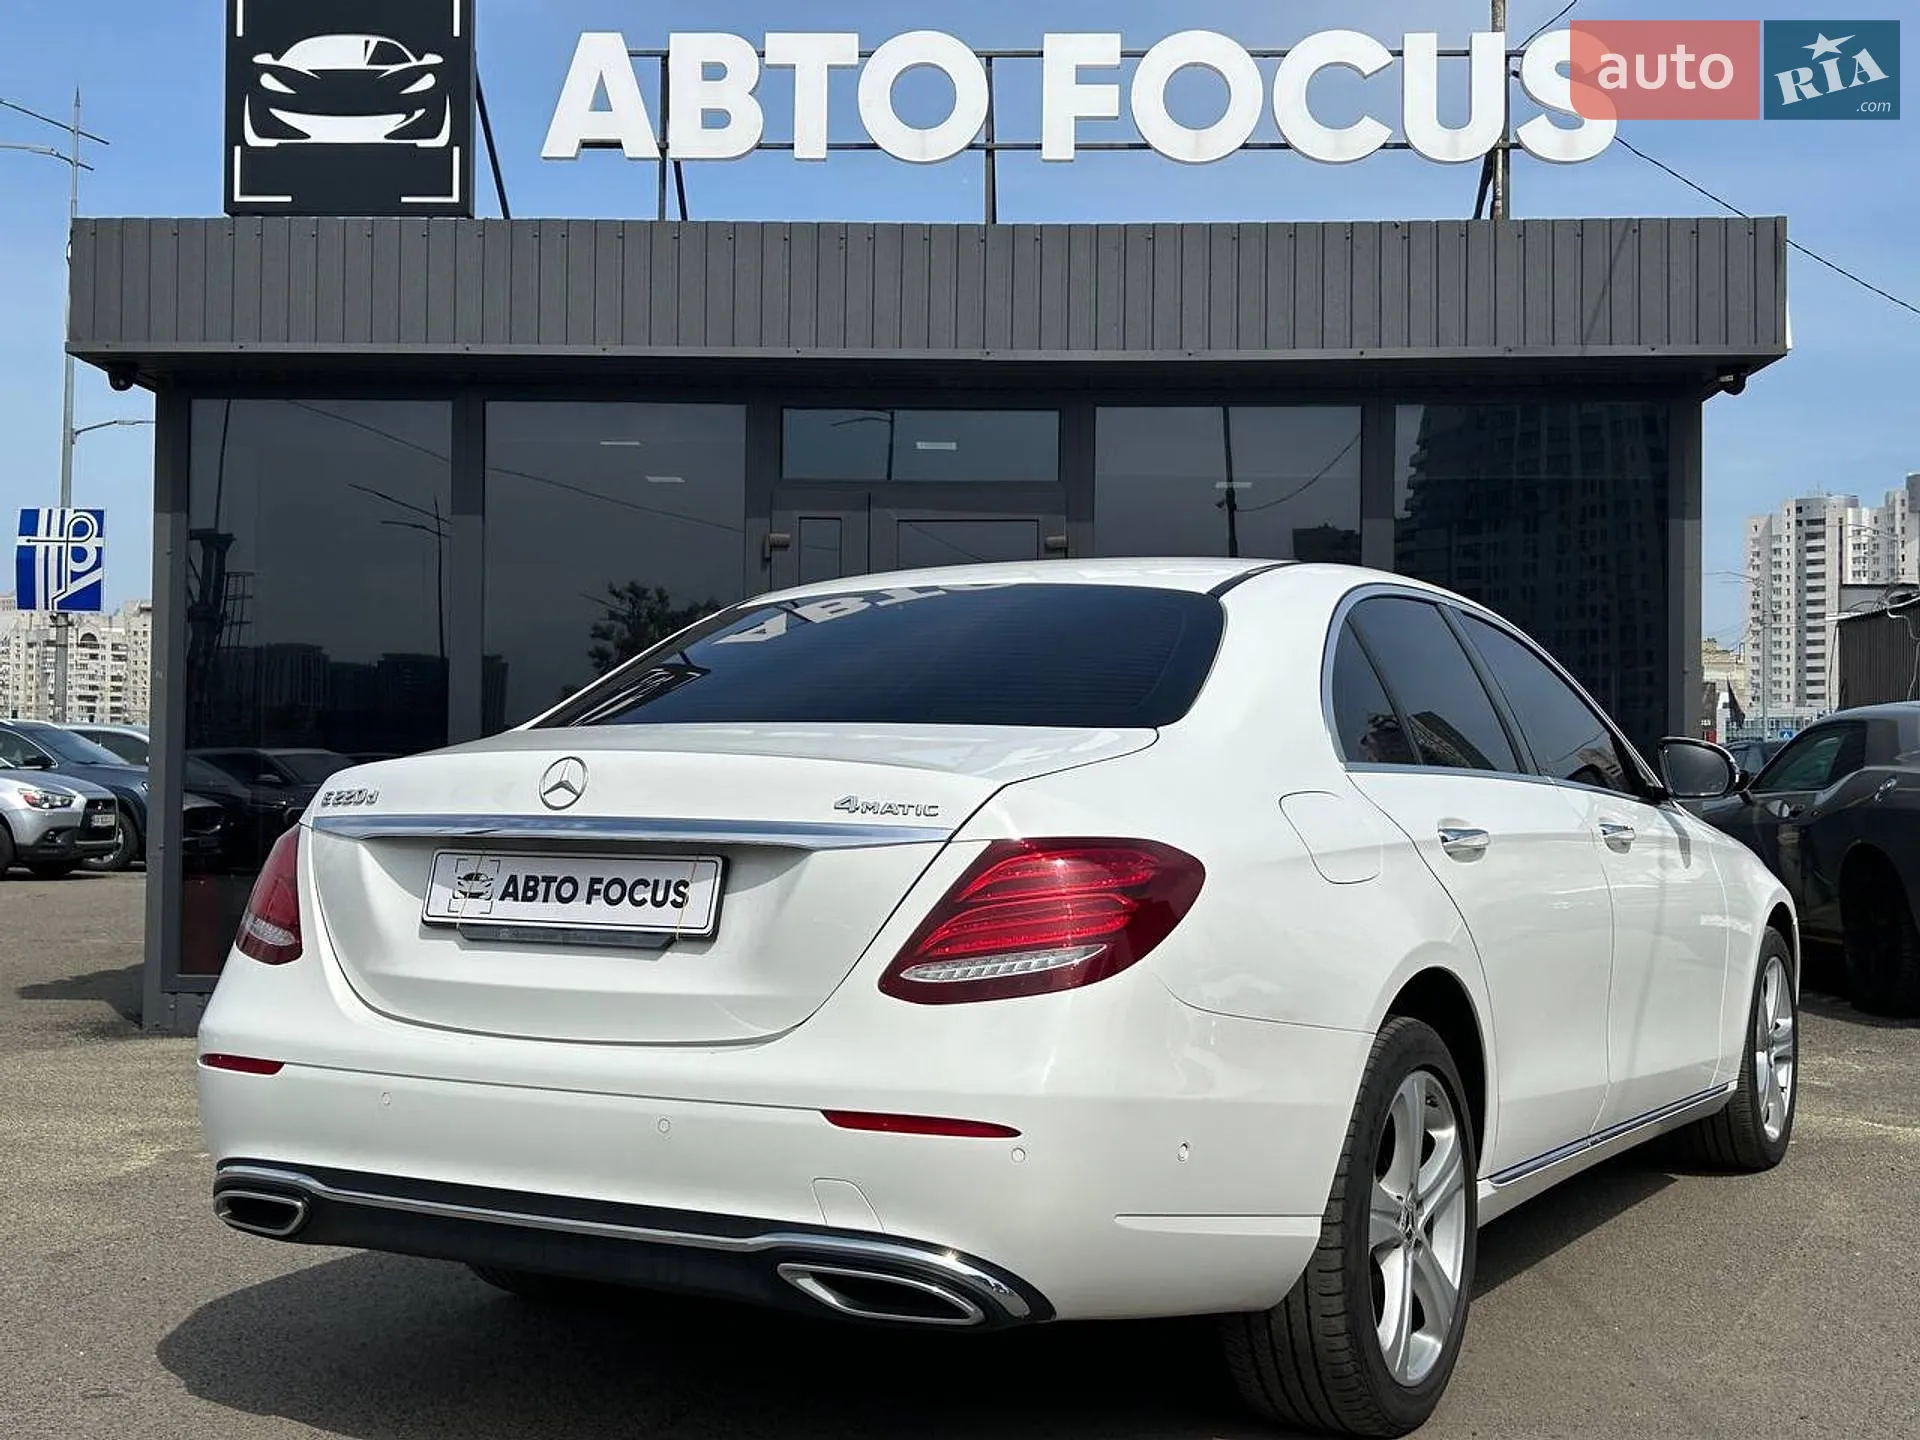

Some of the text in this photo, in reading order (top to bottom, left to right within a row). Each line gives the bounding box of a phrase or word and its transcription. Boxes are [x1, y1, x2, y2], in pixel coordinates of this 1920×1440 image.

[541, 29, 1619, 164] АВТО FOCUS
[834, 795, 940, 818] 4MATIC
[499, 873, 691, 909] АВТО FOCUS
